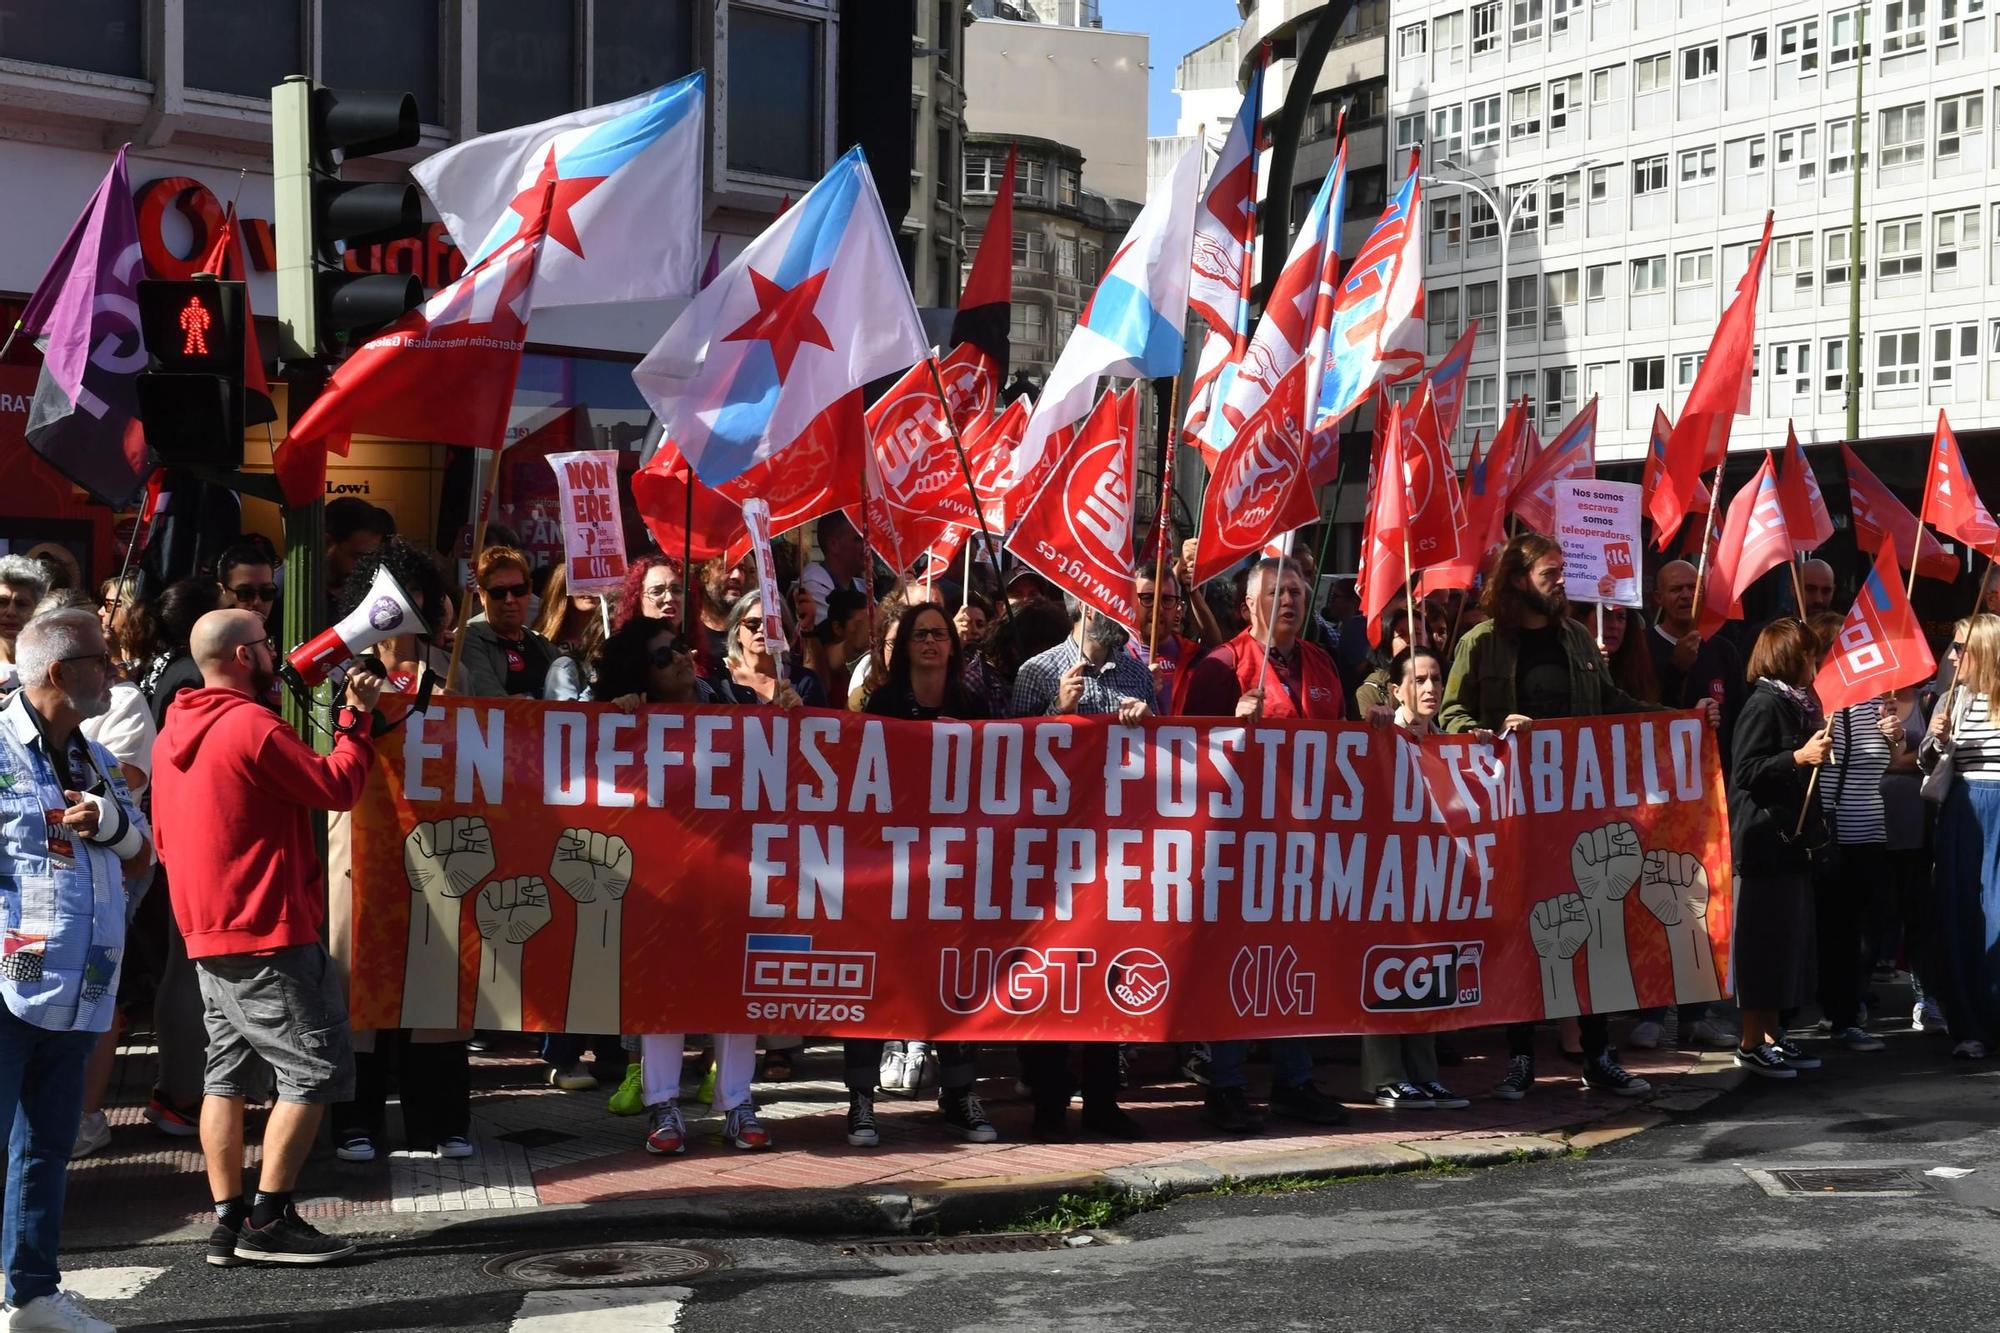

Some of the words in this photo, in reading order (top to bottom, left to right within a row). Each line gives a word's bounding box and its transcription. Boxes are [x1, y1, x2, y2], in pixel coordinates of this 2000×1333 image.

[877, 401, 952, 479] UGT
[326, 481, 370, 494] Lowi
[564, 461, 610, 489] NON
[1573, 488, 1591, 498] Nos
[1593, 490, 1624, 502] somos
[1578, 502, 1619, 514] escravas
[573, 495, 612, 523] ERE
[1583, 515, 1614, 526] somos
[1562, 525, 1634, 542] teleoperadoras.
[403, 706, 504, 805] EN
[543, 710, 893, 814] DEFENSA
[929, 722, 1073, 817] DOS
[1104, 723, 1369, 821] POSTOS
[1440, 719, 1702, 824] TRABALLO
[748, 823, 845, 921] EN
[882, 826, 1497, 922] TELEPERFORMANCE
[754, 961, 865, 988] CCOO
[939, 946, 1097, 1014] UGT
[1229, 945, 1316, 1017] CIG
[1373, 953, 1453, 1001] CGT
[1459, 987, 1479, 1001] CGT
[745, 999, 865, 1022] servizos
